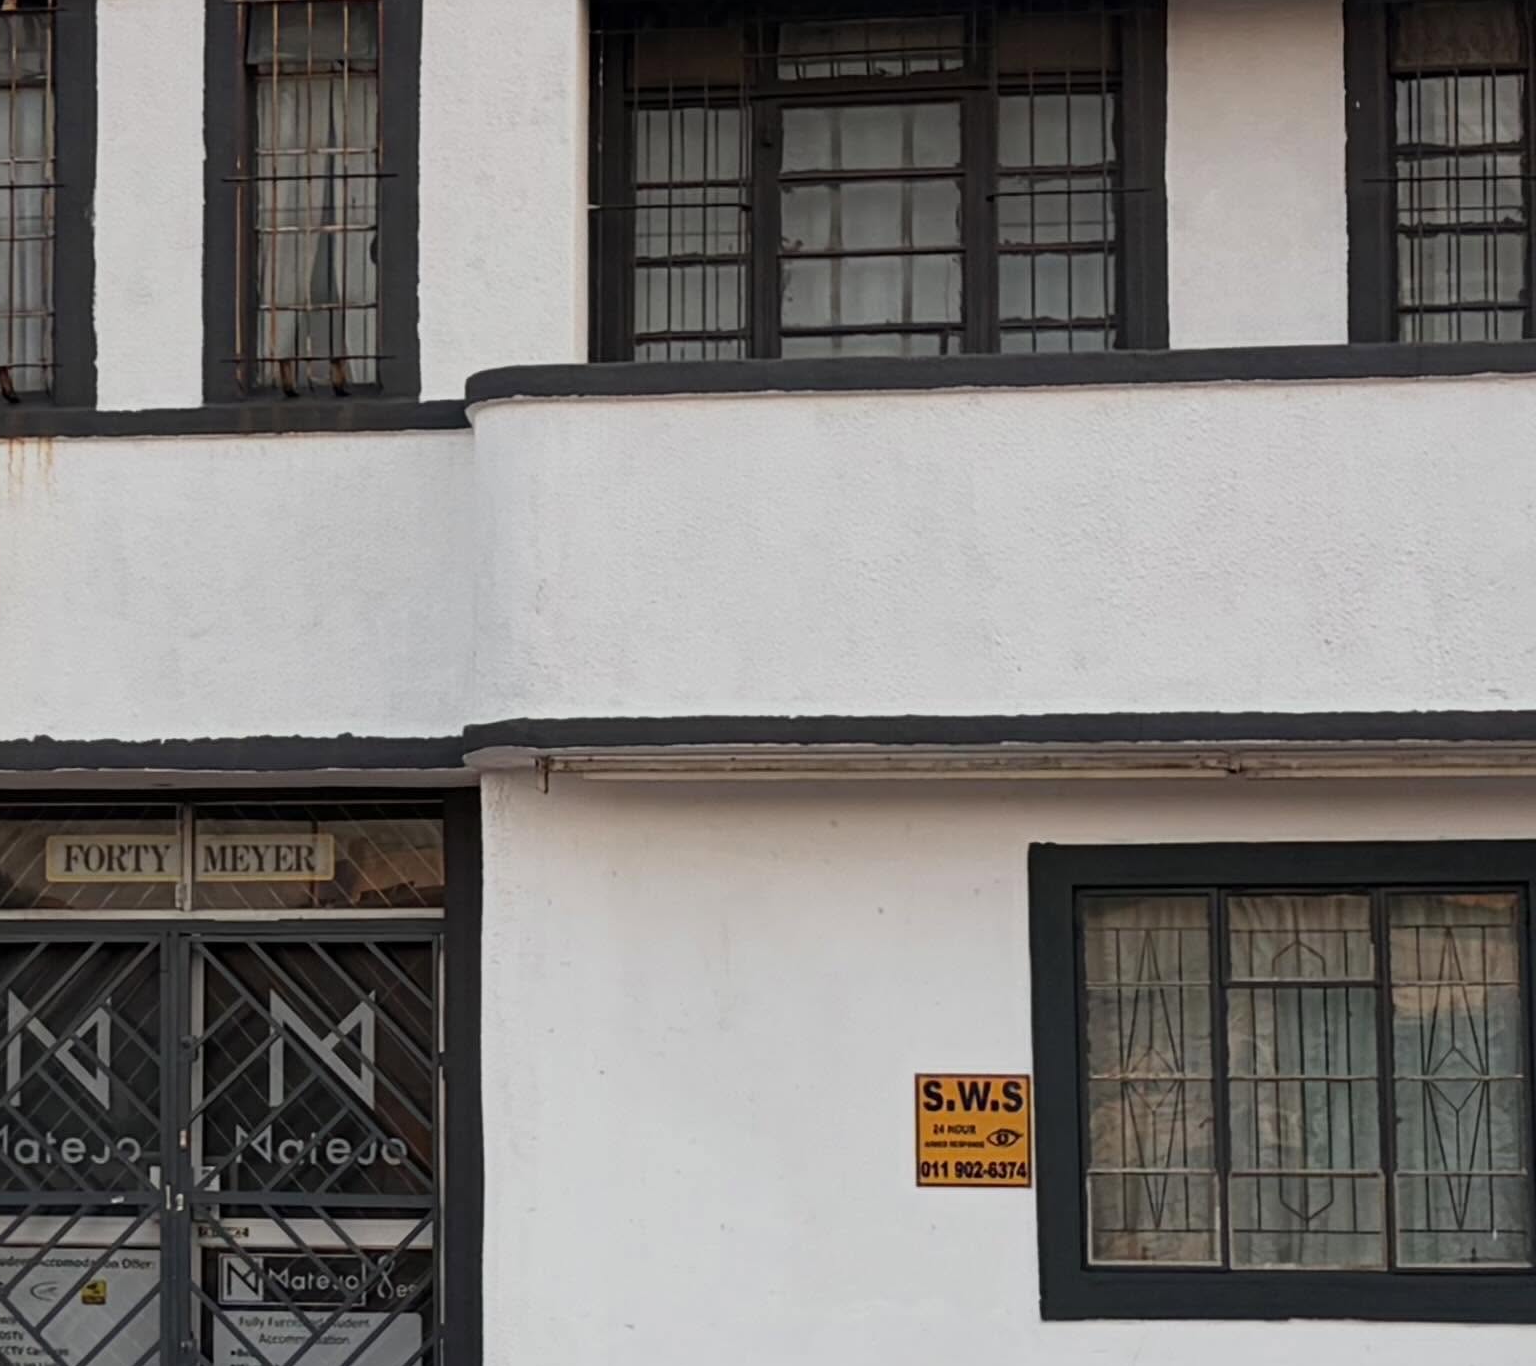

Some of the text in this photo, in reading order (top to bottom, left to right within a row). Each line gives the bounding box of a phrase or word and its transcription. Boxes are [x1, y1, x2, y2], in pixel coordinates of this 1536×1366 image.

[64, 843, 316, 873] FORTY MEYER
[922, 1079, 1024, 1113] S.W.S
[932, 1124, 945, 1135] 24
[921, 1161, 1027, 1179] 011 902-6374
